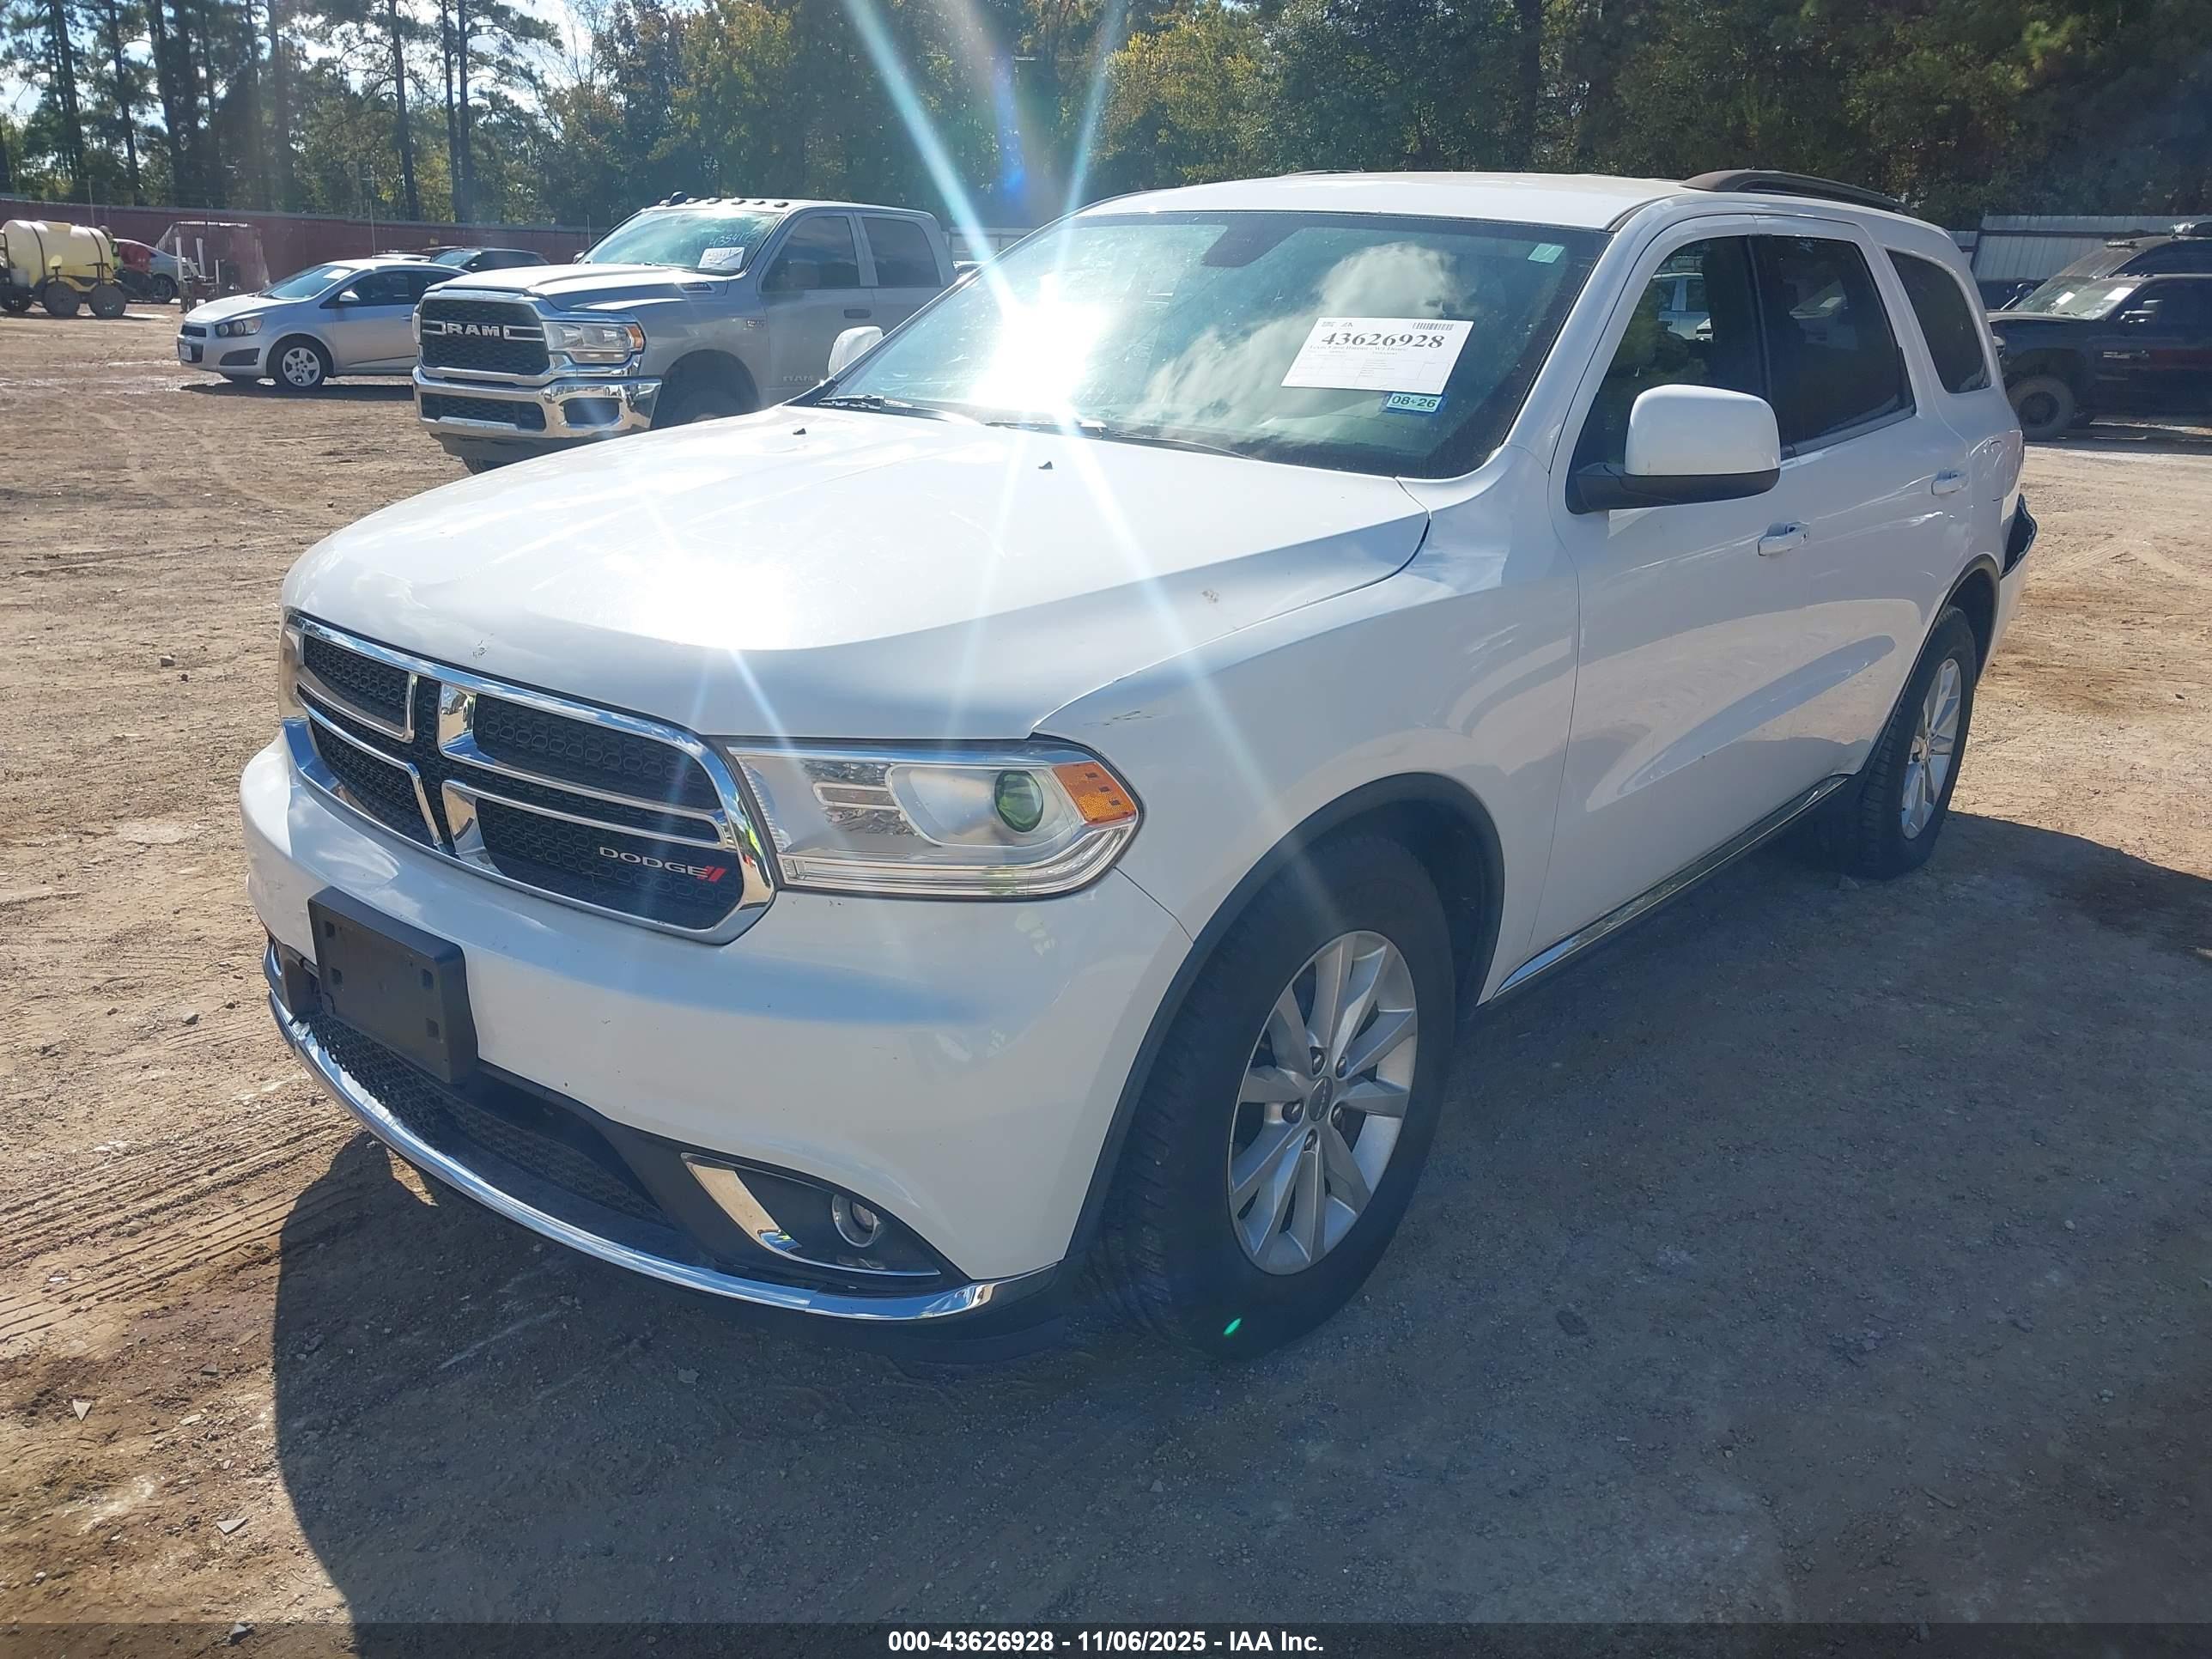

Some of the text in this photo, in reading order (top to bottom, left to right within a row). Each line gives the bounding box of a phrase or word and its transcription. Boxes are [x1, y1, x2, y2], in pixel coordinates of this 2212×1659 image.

[447, 322, 500, 337] RAM
[1321, 331, 1445, 349] 43626928
[599, 846, 708, 878] DODGE
